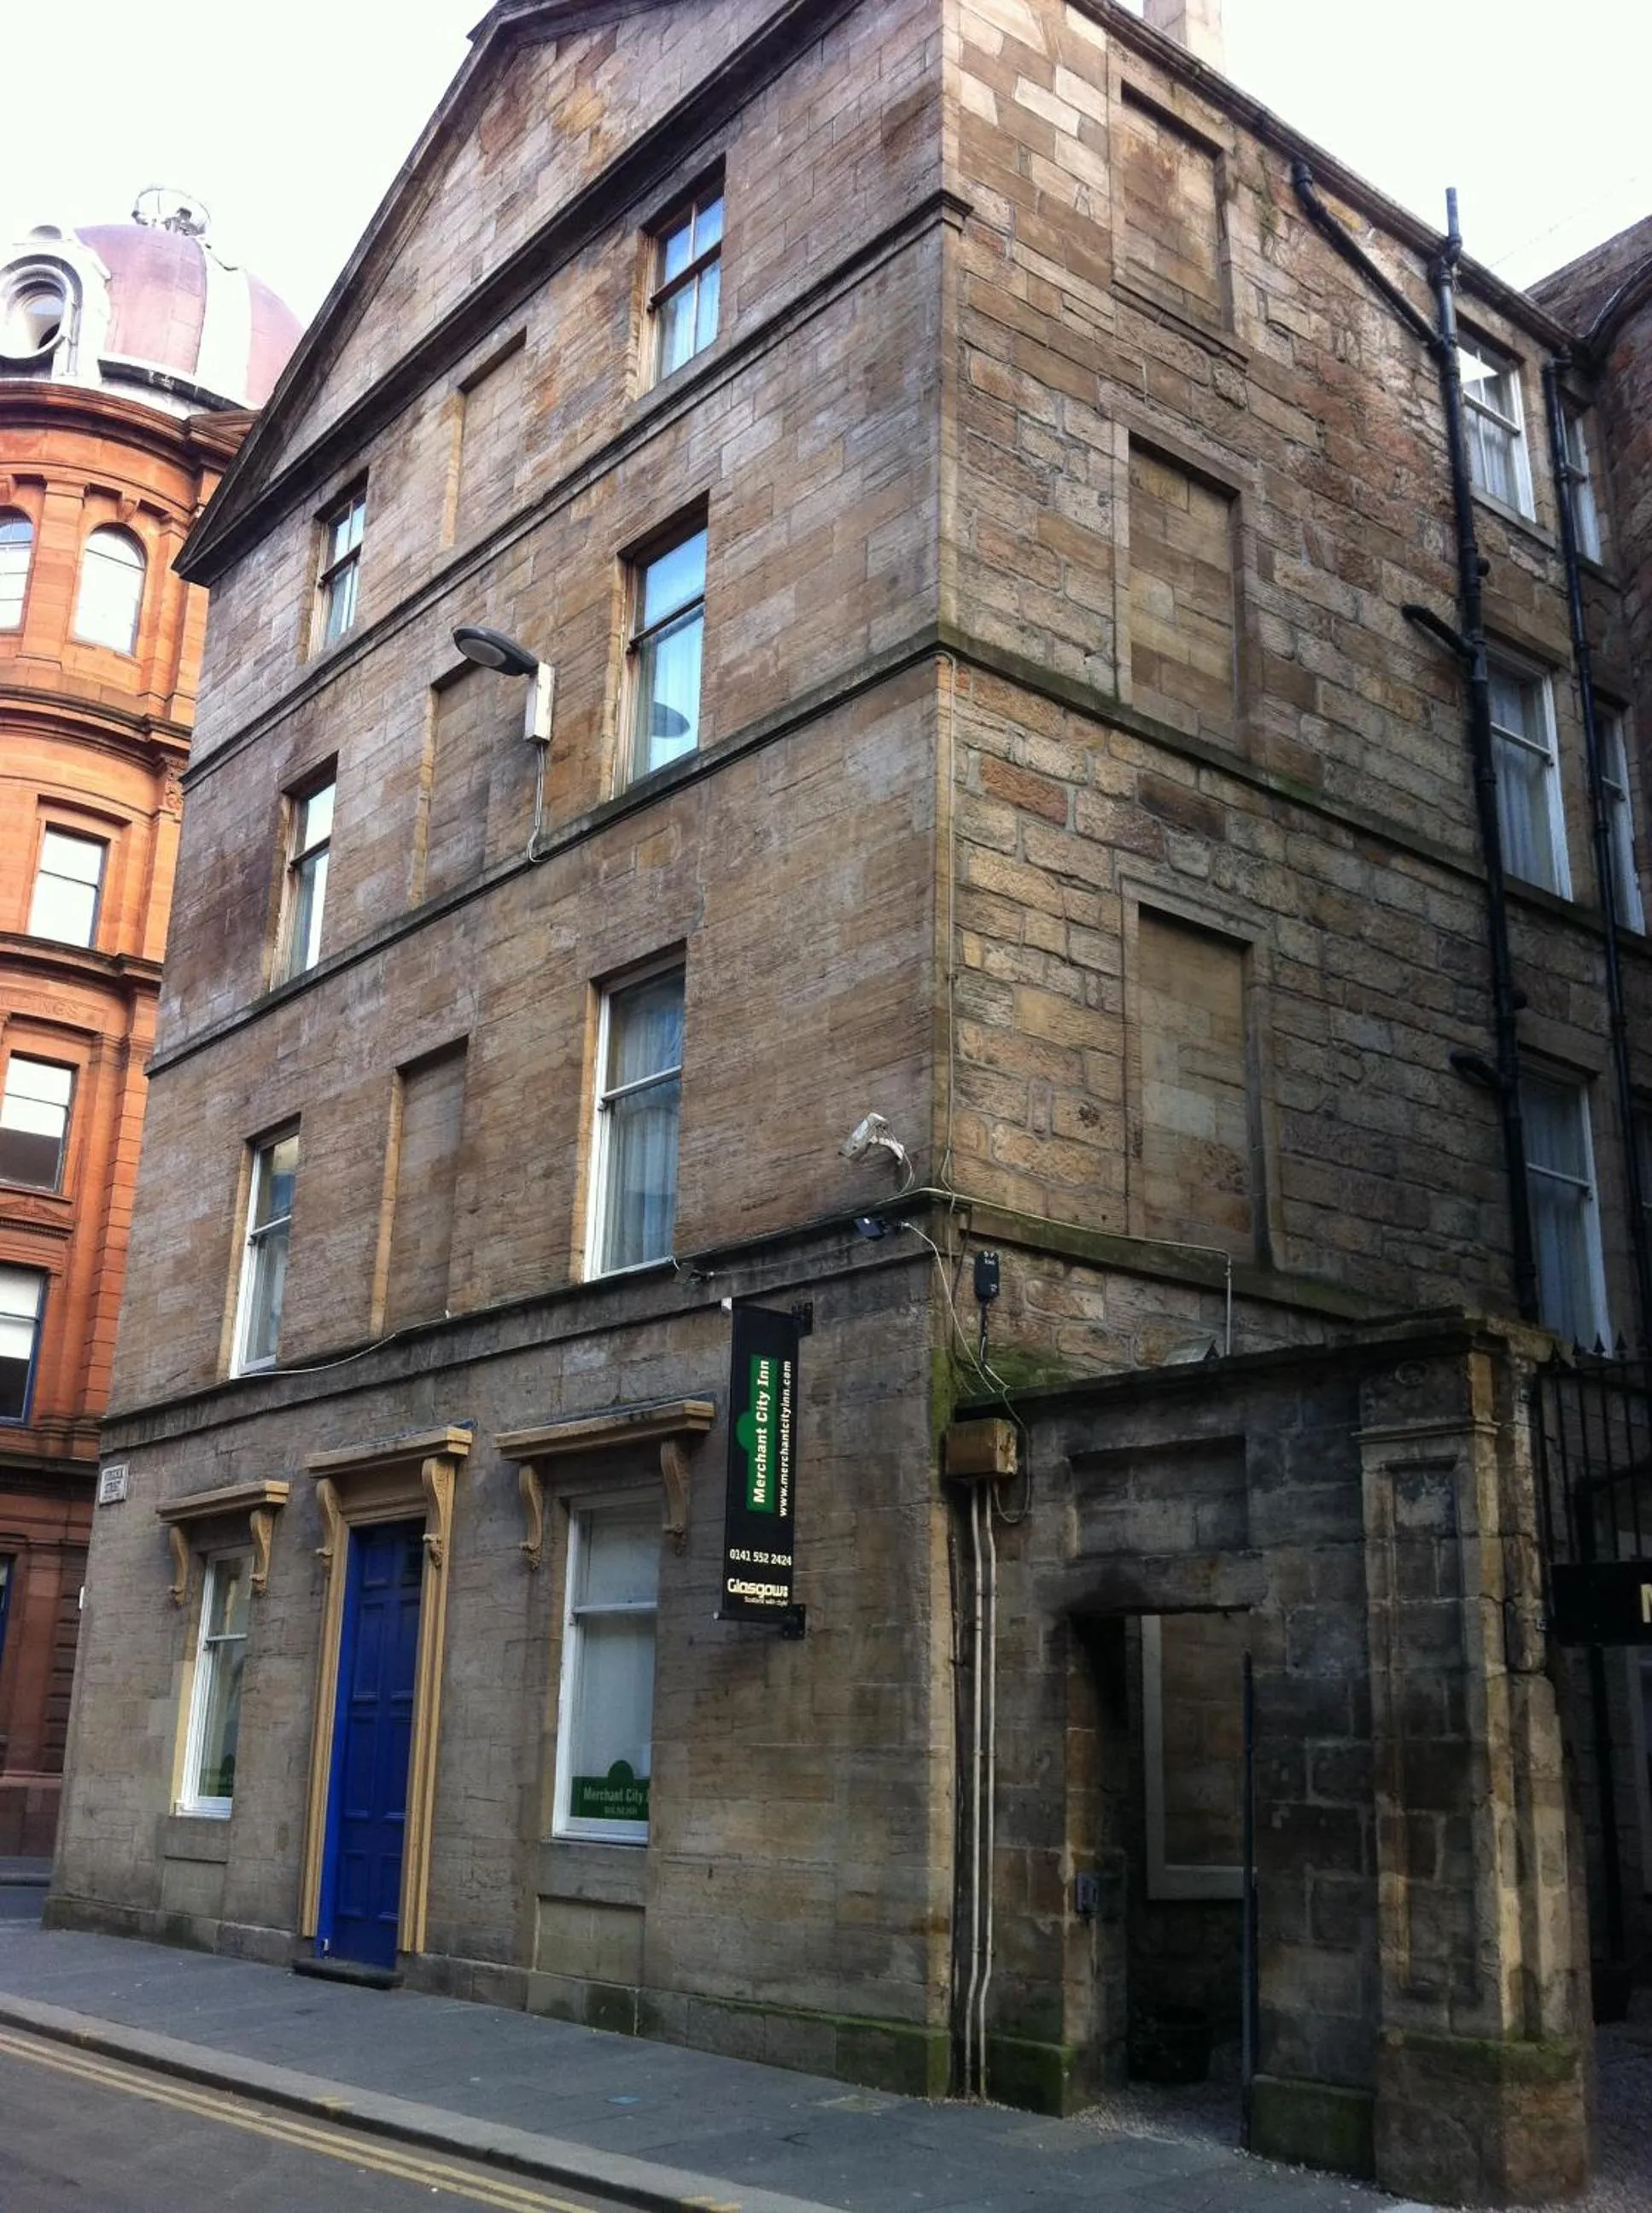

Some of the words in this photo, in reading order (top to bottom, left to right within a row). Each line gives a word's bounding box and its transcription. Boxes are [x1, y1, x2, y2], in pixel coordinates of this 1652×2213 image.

[757, 1360, 769, 1387] Inn
[756, 1391, 771, 1423] City
[779, 1361, 791, 1517] www.merchantcityinn.com
[753, 1428, 768, 1503] Merchant
[729, 1549, 751, 1562] 0141
[753, 1550, 769, 1563] 552
[771, 1553, 791, 1566] 2424
[583, 1786, 623, 1801] Merchant
[626, 1788, 644, 1806] City
